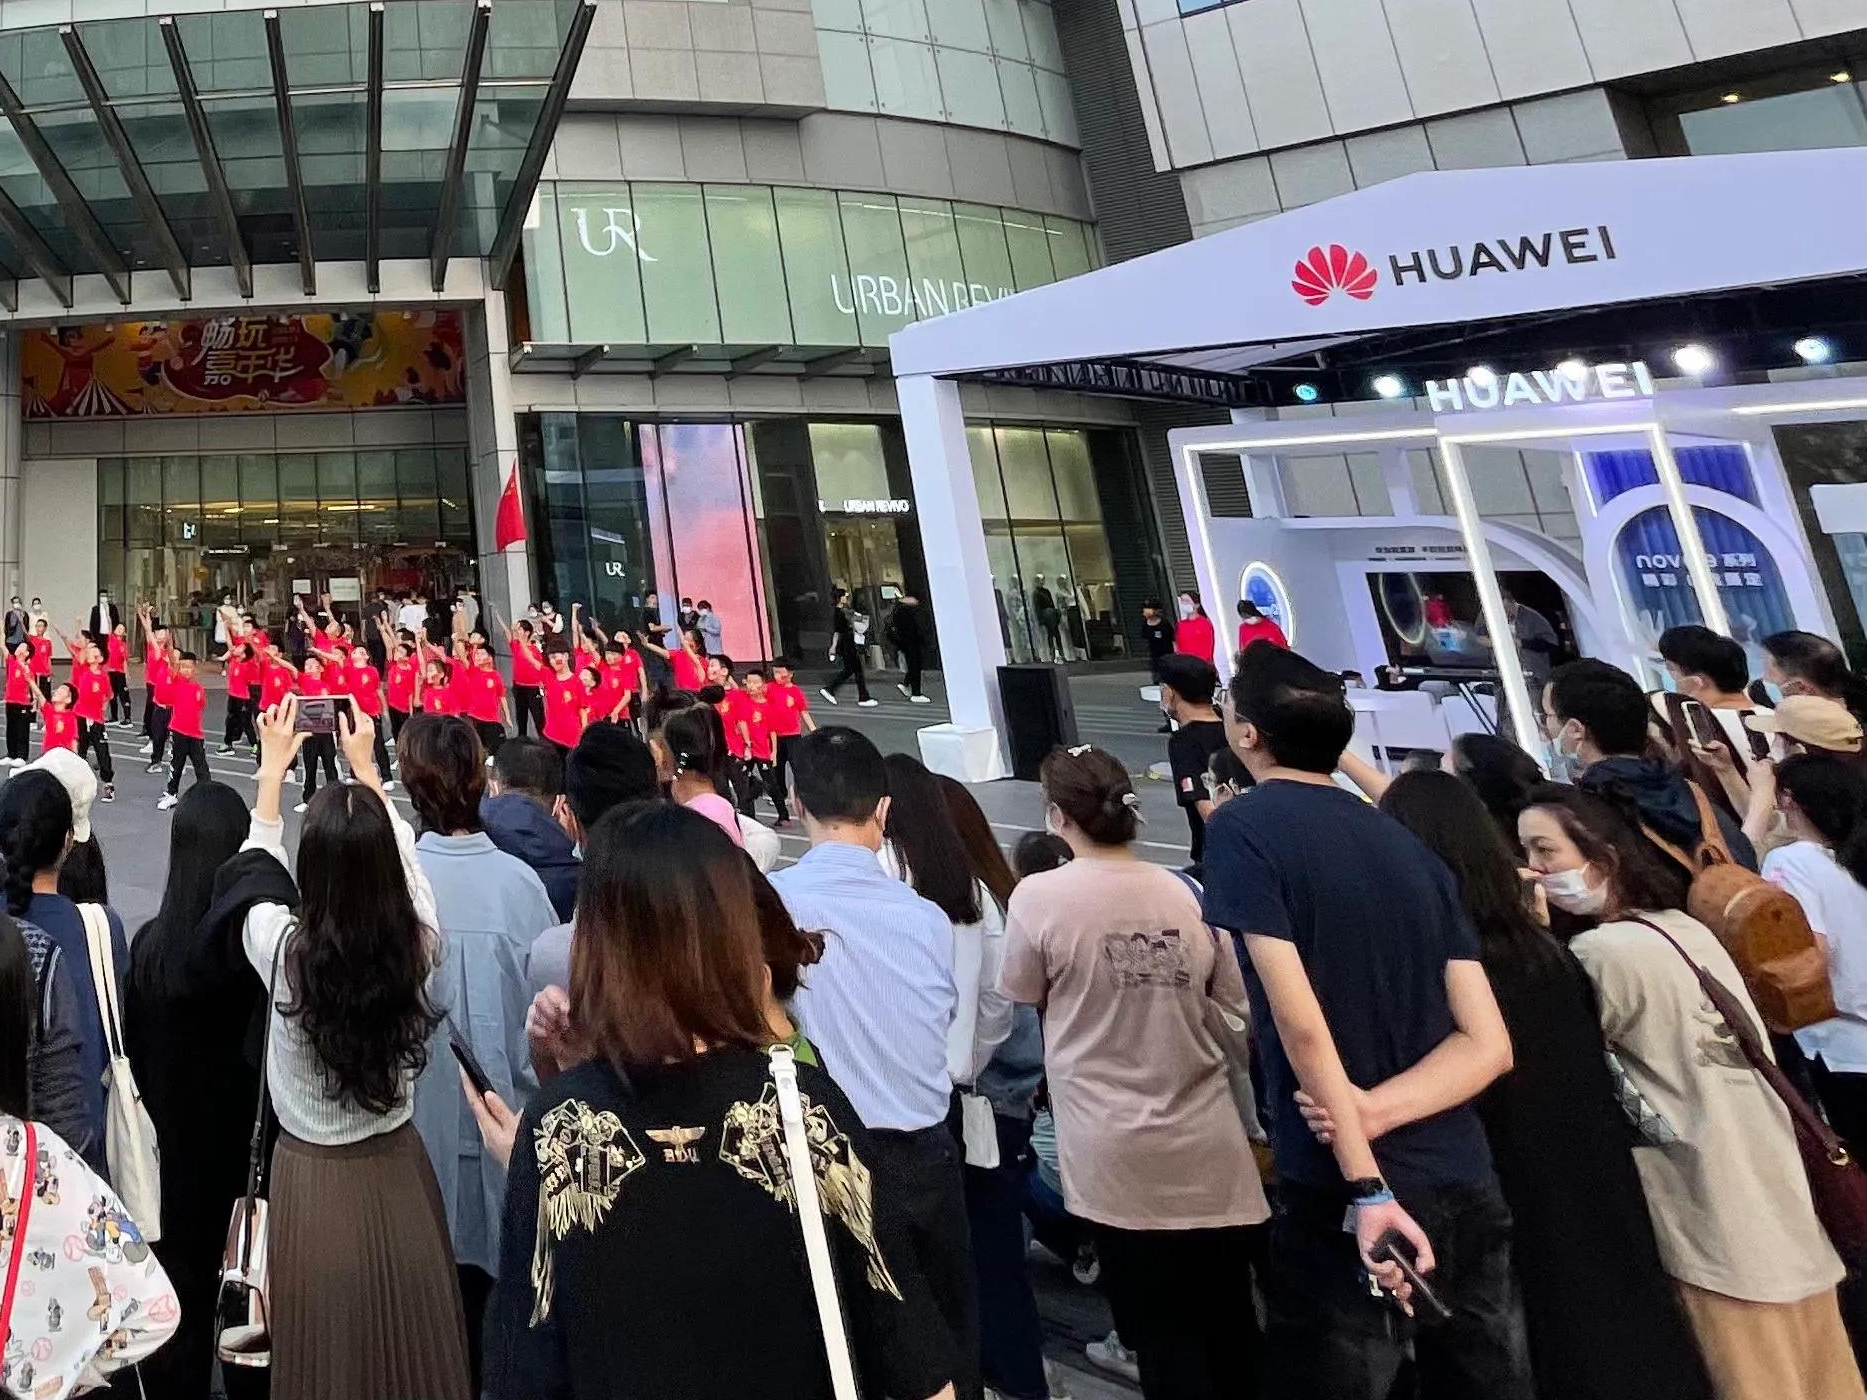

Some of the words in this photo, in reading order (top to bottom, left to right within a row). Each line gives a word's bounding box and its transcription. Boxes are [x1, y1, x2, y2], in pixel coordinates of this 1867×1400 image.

[570, 207, 659, 262] UR
[1388, 225, 1617, 287] HUAWEI
[830, 274, 950, 317] URBAN
[1424, 361, 1655, 412] HUAWEI
